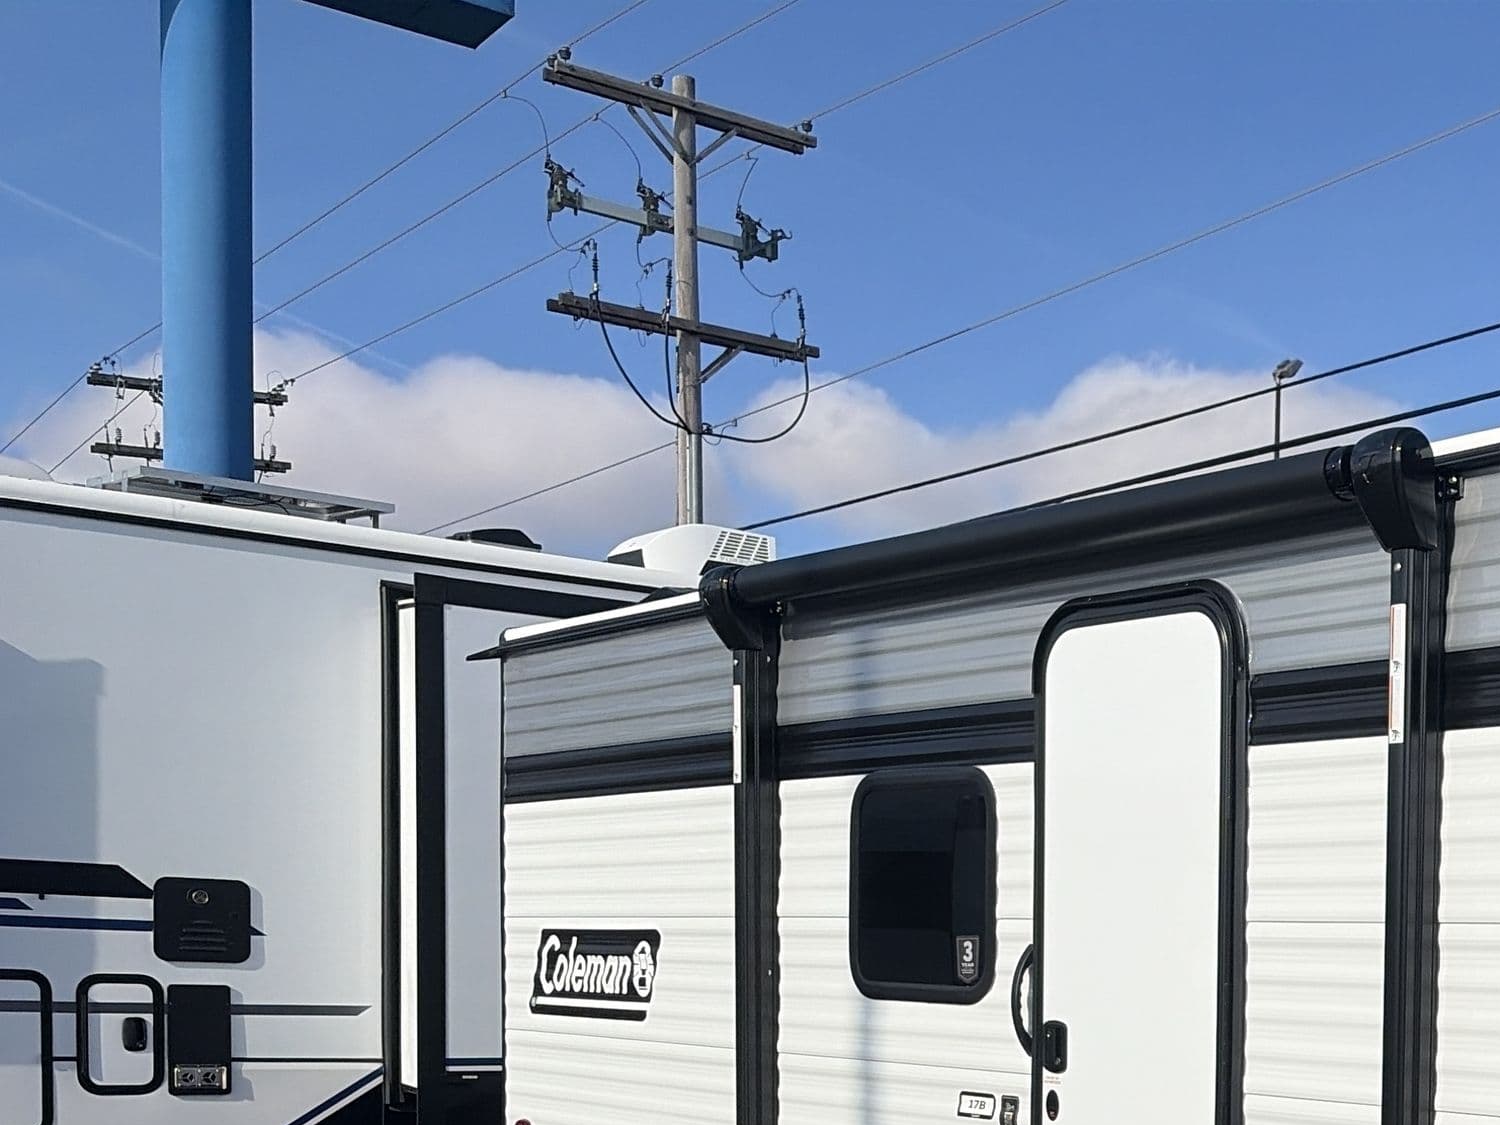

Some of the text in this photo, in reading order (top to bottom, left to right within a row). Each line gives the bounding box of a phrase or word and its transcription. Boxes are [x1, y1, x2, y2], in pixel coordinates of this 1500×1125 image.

[963, 940, 973, 962] 3
[539, 934, 632, 995] Coleman
[968, 1099, 986, 1110] 17B
